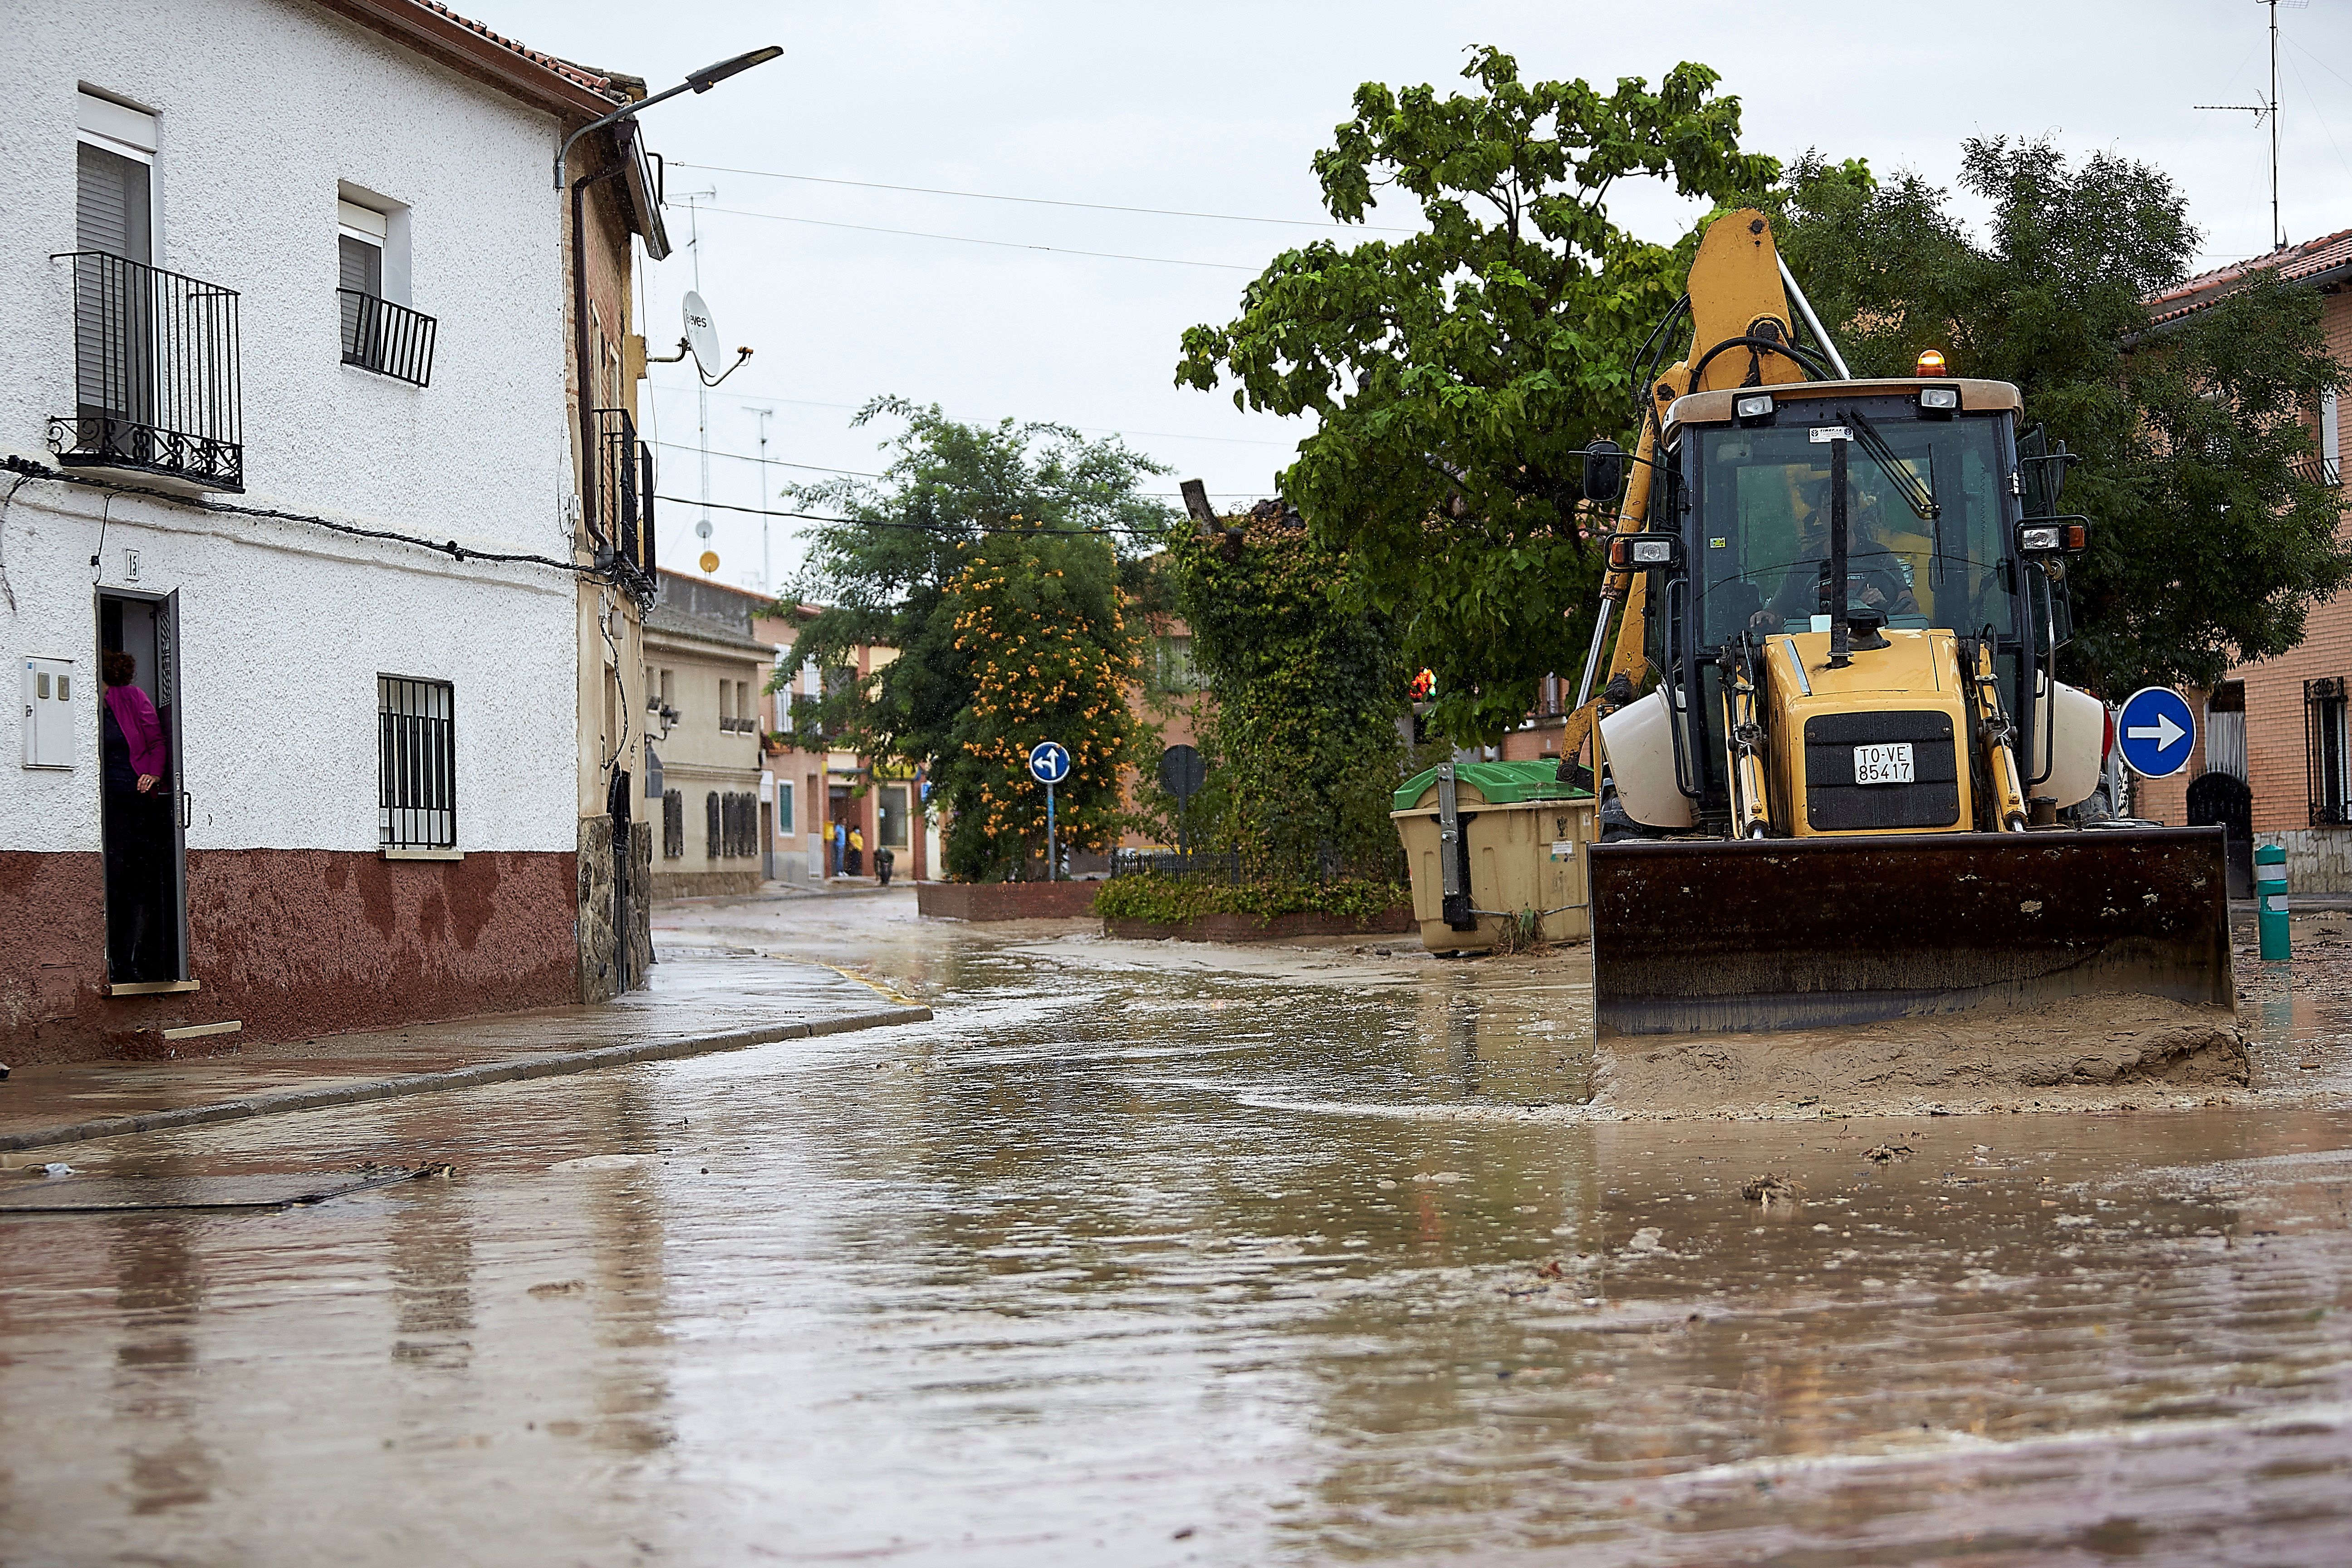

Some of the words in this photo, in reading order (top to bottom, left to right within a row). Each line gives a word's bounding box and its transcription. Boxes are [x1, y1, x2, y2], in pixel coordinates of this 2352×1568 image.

[129, 554, 137, 576] 15
[1860, 747, 1906, 764] TO-VE
[1859, 763, 1910, 780] 85417
